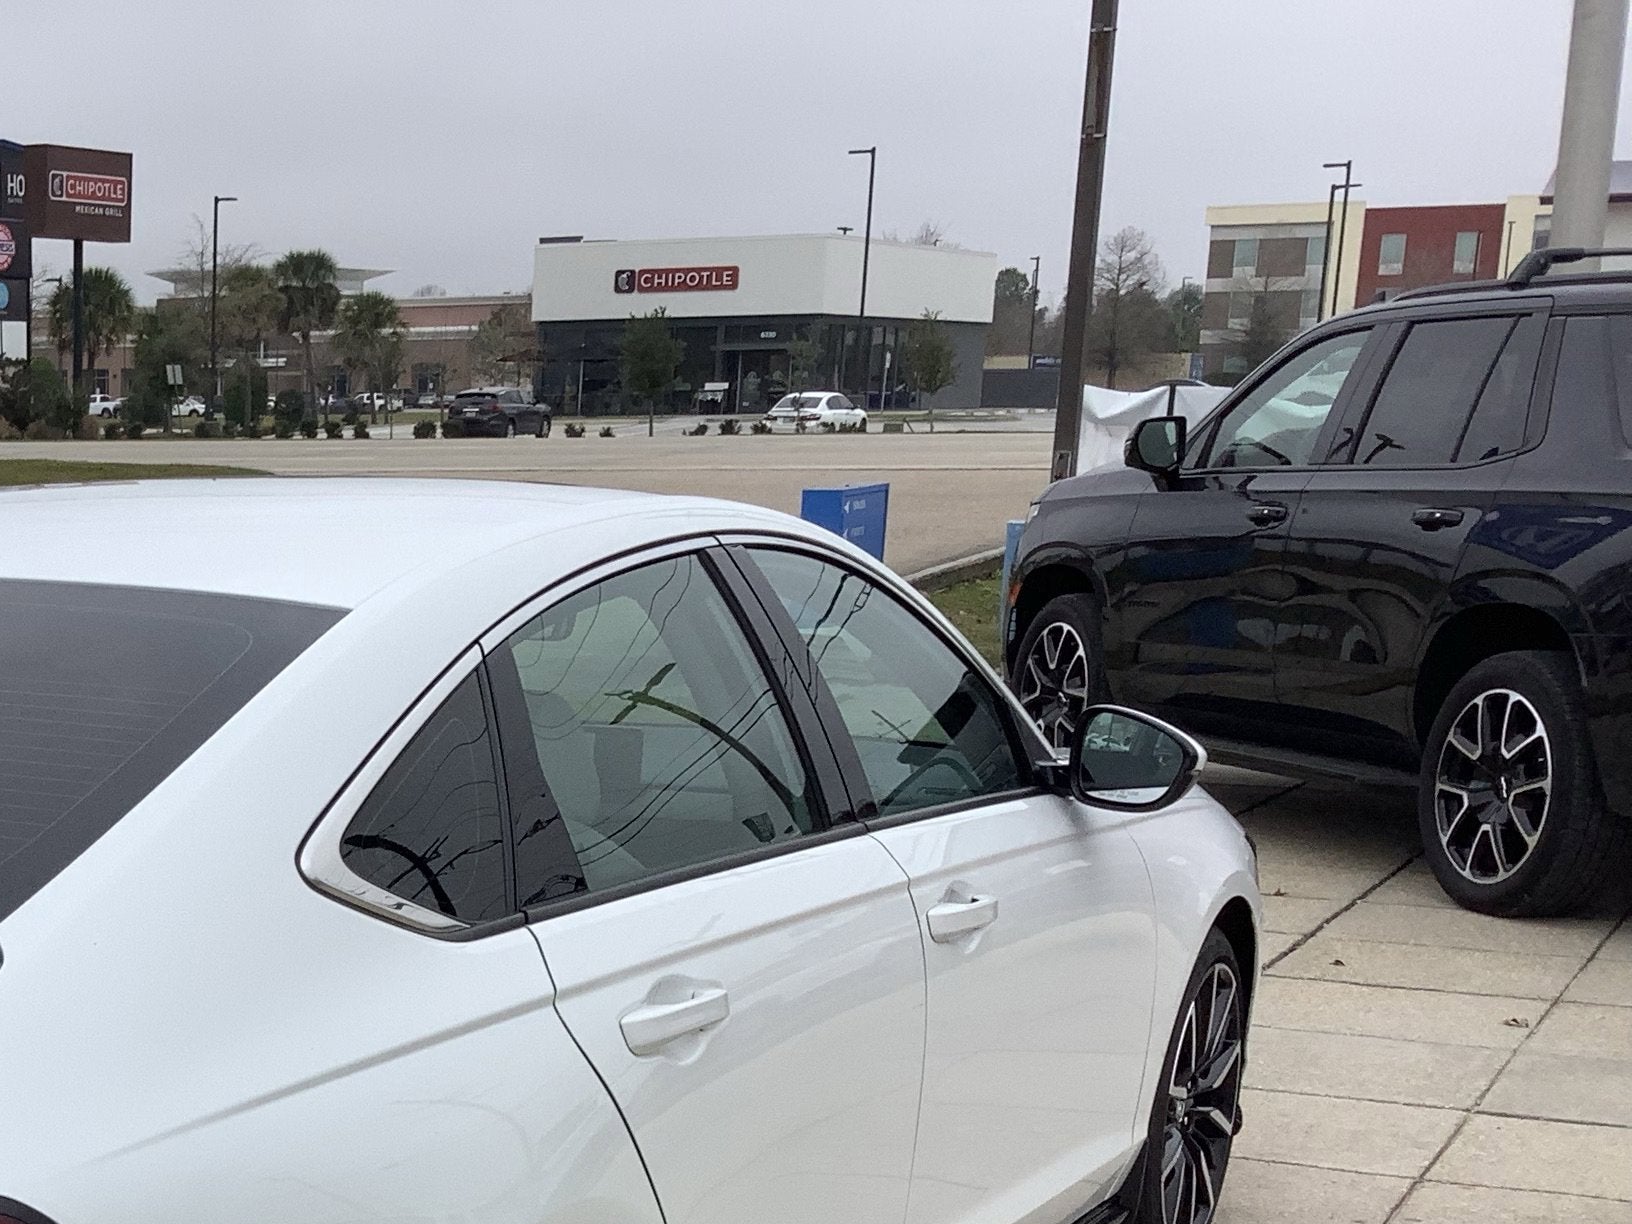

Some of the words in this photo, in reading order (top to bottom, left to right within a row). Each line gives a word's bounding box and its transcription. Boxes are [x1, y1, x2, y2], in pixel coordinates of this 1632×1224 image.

[67, 179, 124, 199] CHIPOTLE
[75, 205, 104, 216] MEXICAN
[104, 207, 123, 217] GRILL
[640, 270, 734, 288] CHIPOTLE
